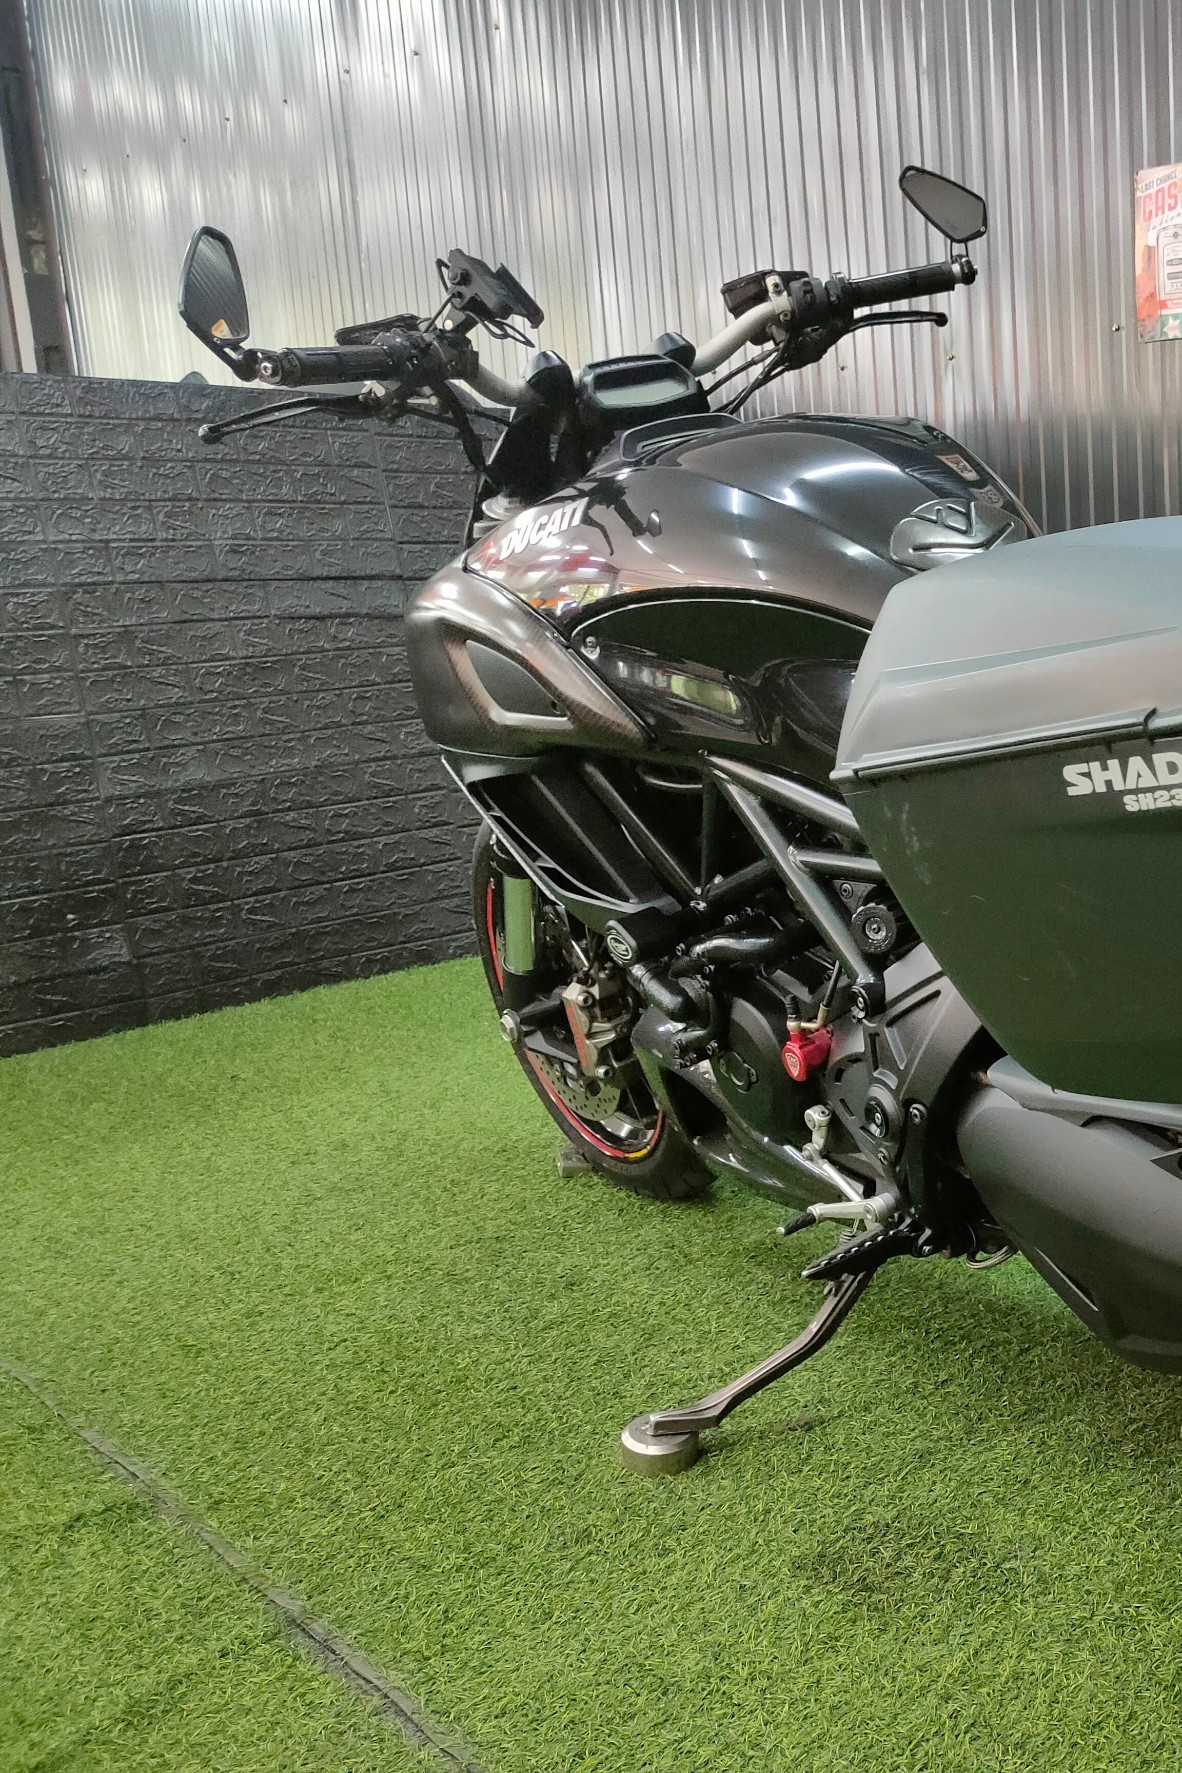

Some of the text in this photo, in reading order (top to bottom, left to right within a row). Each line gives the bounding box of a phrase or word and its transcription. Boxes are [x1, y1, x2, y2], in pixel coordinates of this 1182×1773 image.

[1141, 169, 1177, 193] LAST CHANCE
[1142, 181, 1178, 222] GAS
[500, 497, 589, 560] DUCATI
